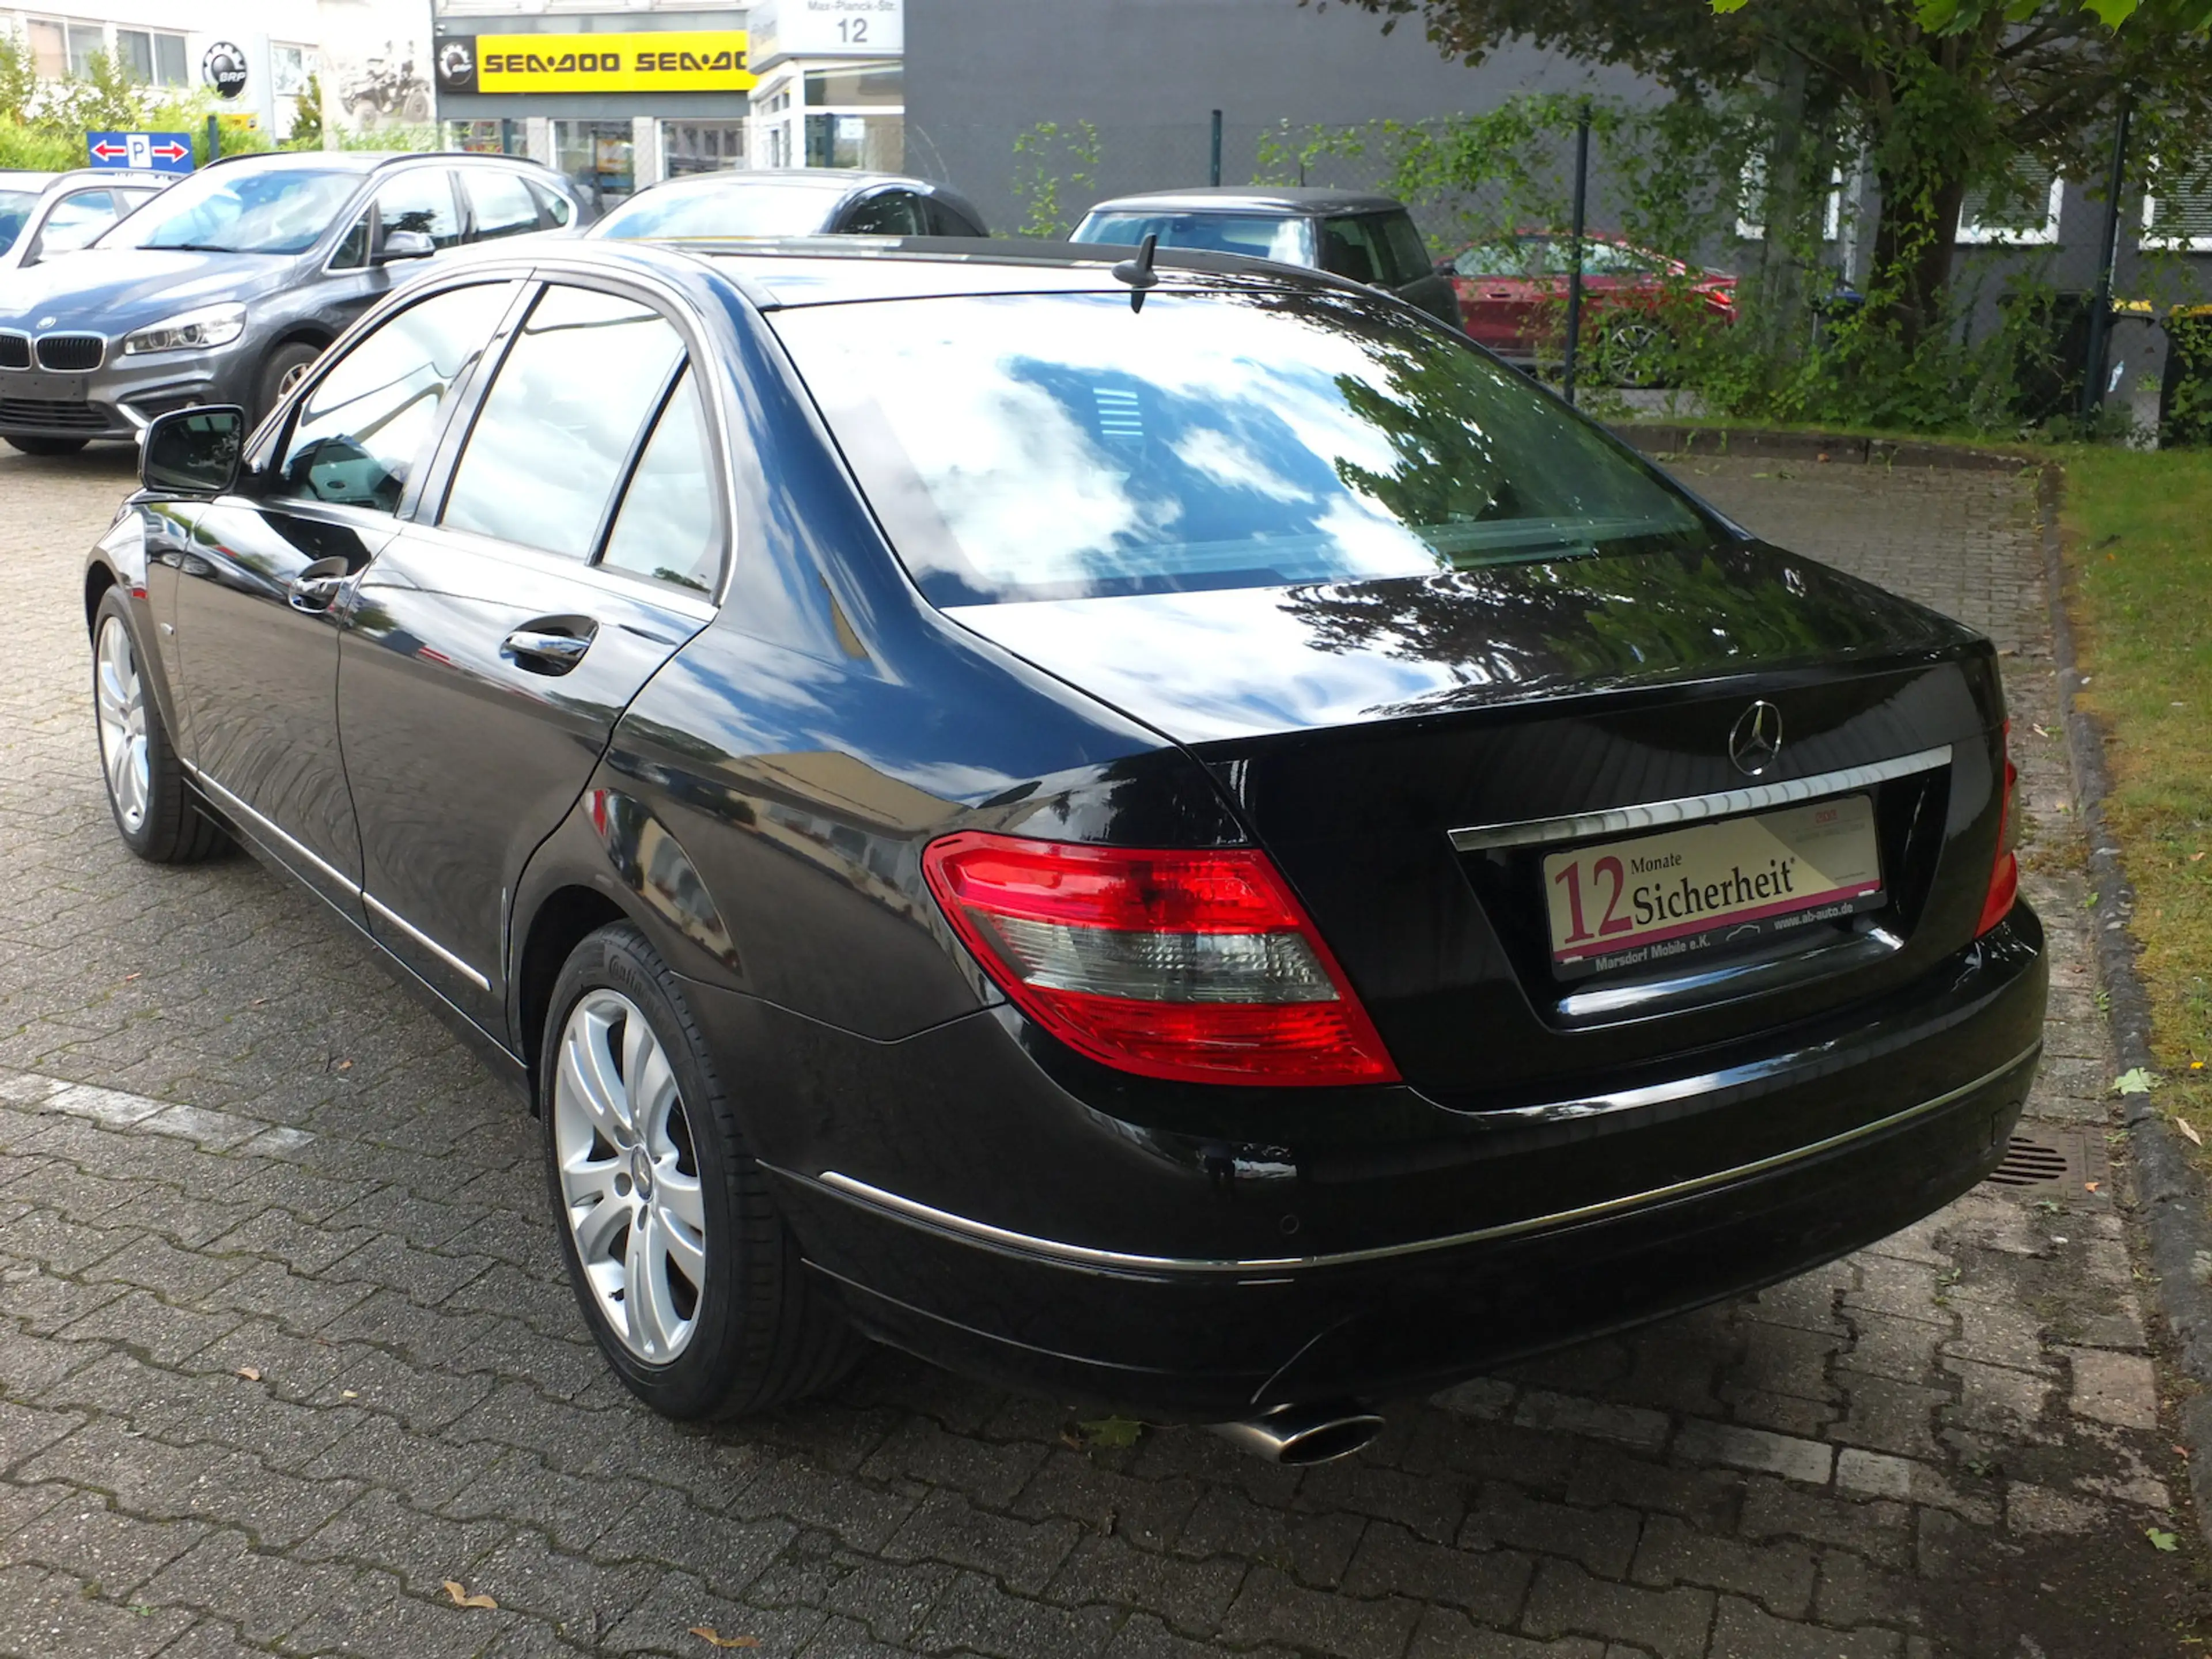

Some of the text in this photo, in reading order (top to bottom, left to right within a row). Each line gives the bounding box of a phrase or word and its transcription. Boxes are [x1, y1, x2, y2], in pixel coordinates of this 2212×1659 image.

[837, 18, 868, 43] 12
[219, 71, 246, 82] BRP
[133, 142, 145, 161] P
[1631, 853, 1682, 874] Monate
[1555, 855, 1633, 944] 12
[1774, 902, 1853, 930] www.ab-auto.de
[1596, 948, 1647, 971] Marsdorf
[1651, 940, 1687, 959] Mobile
